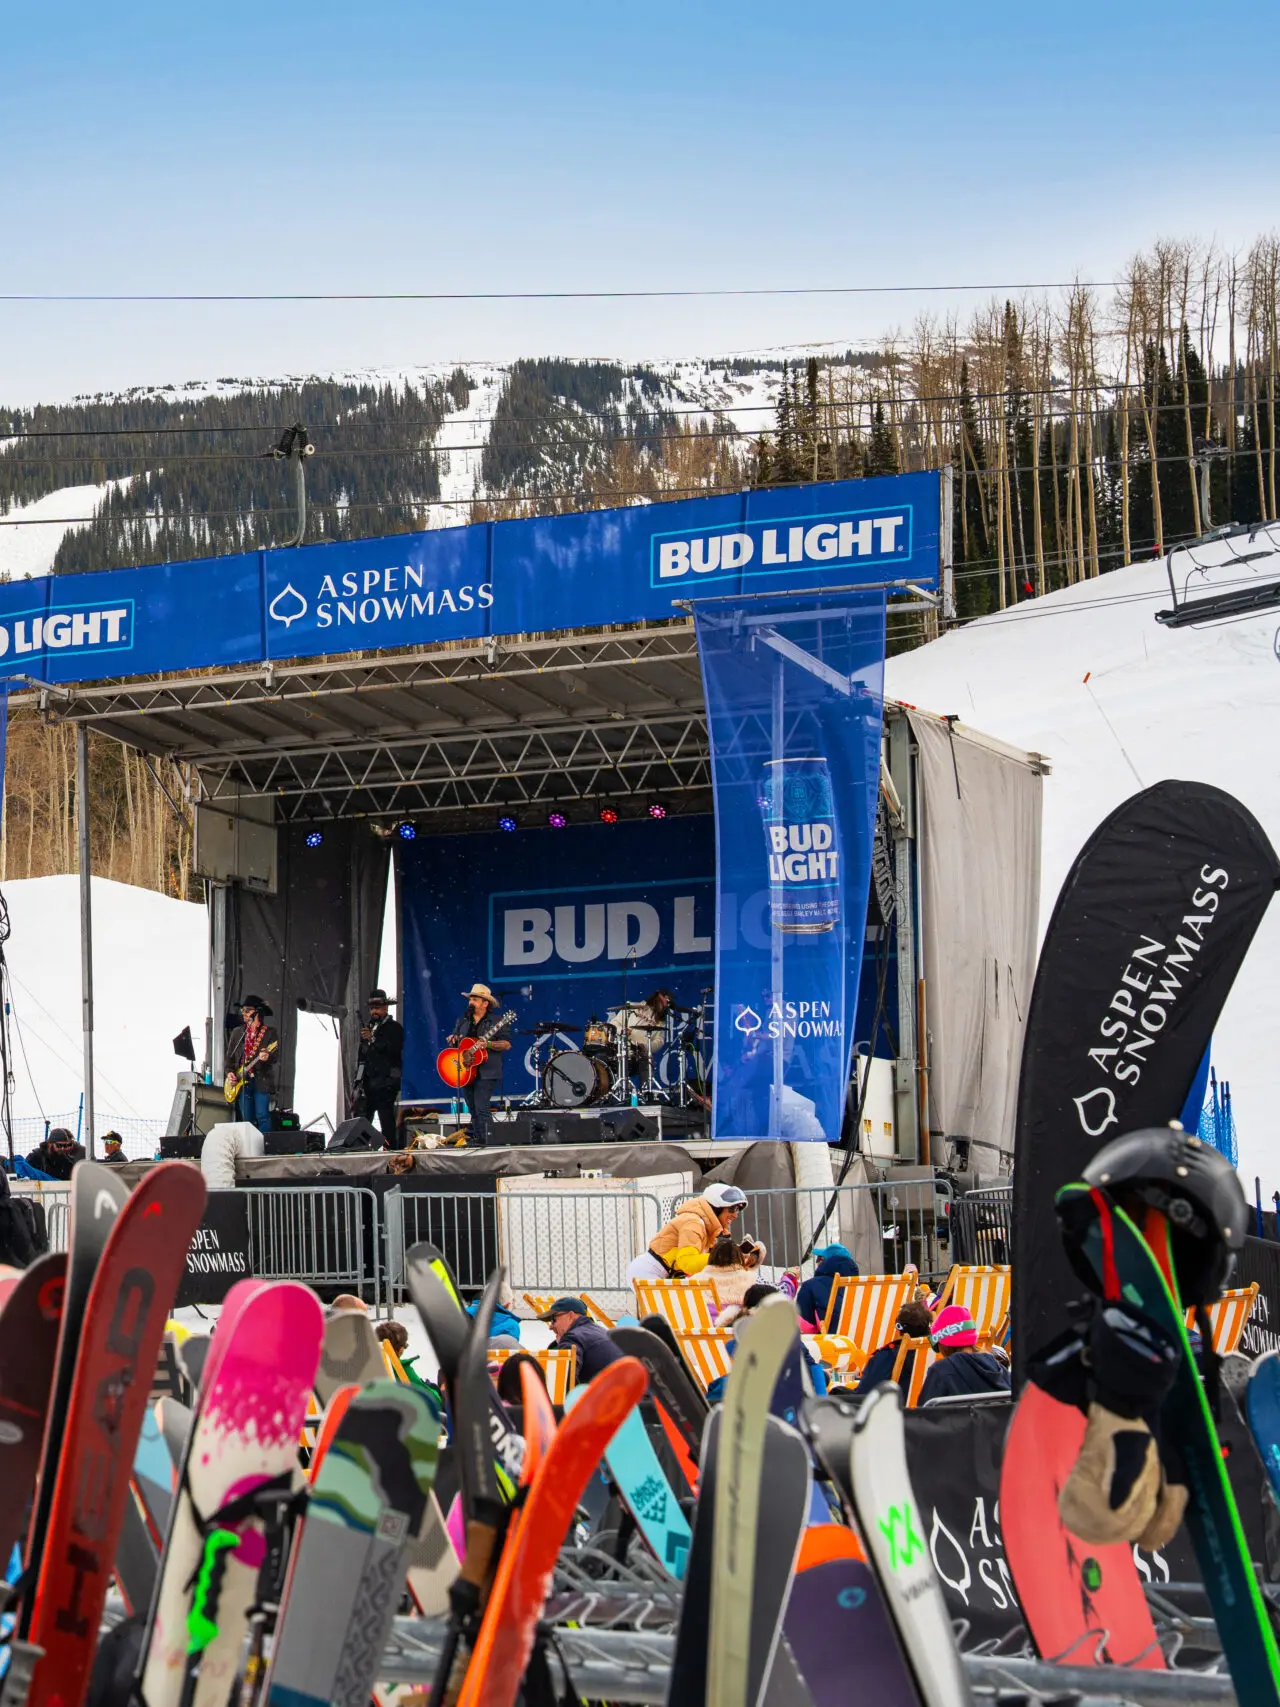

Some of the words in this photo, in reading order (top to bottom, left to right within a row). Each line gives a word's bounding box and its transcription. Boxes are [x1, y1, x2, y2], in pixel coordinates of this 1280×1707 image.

[659, 533, 753, 578] BUD
[762, 516, 903, 565] LIGHT
[317, 565, 424, 599] ASPEN
[316, 583, 494, 628] SNOWMASS
[15, 609, 126, 654] LIGHT
[769, 823, 832, 852] BUD
[769, 852, 838, 881] LIGHT
[504, 901, 660, 965] BUD
[1114, 864, 1229, 1085] SNOWMASS
[769, 1001, 830, 1018] ASPEN
[1087, 935, 1166, 1073] ASPEN
[768, 1020, 842, 1038] SNOWMA
[189, 1229, 220, 1250] SPEN
[186, 1252, 246, 1273] SNOWMASS
